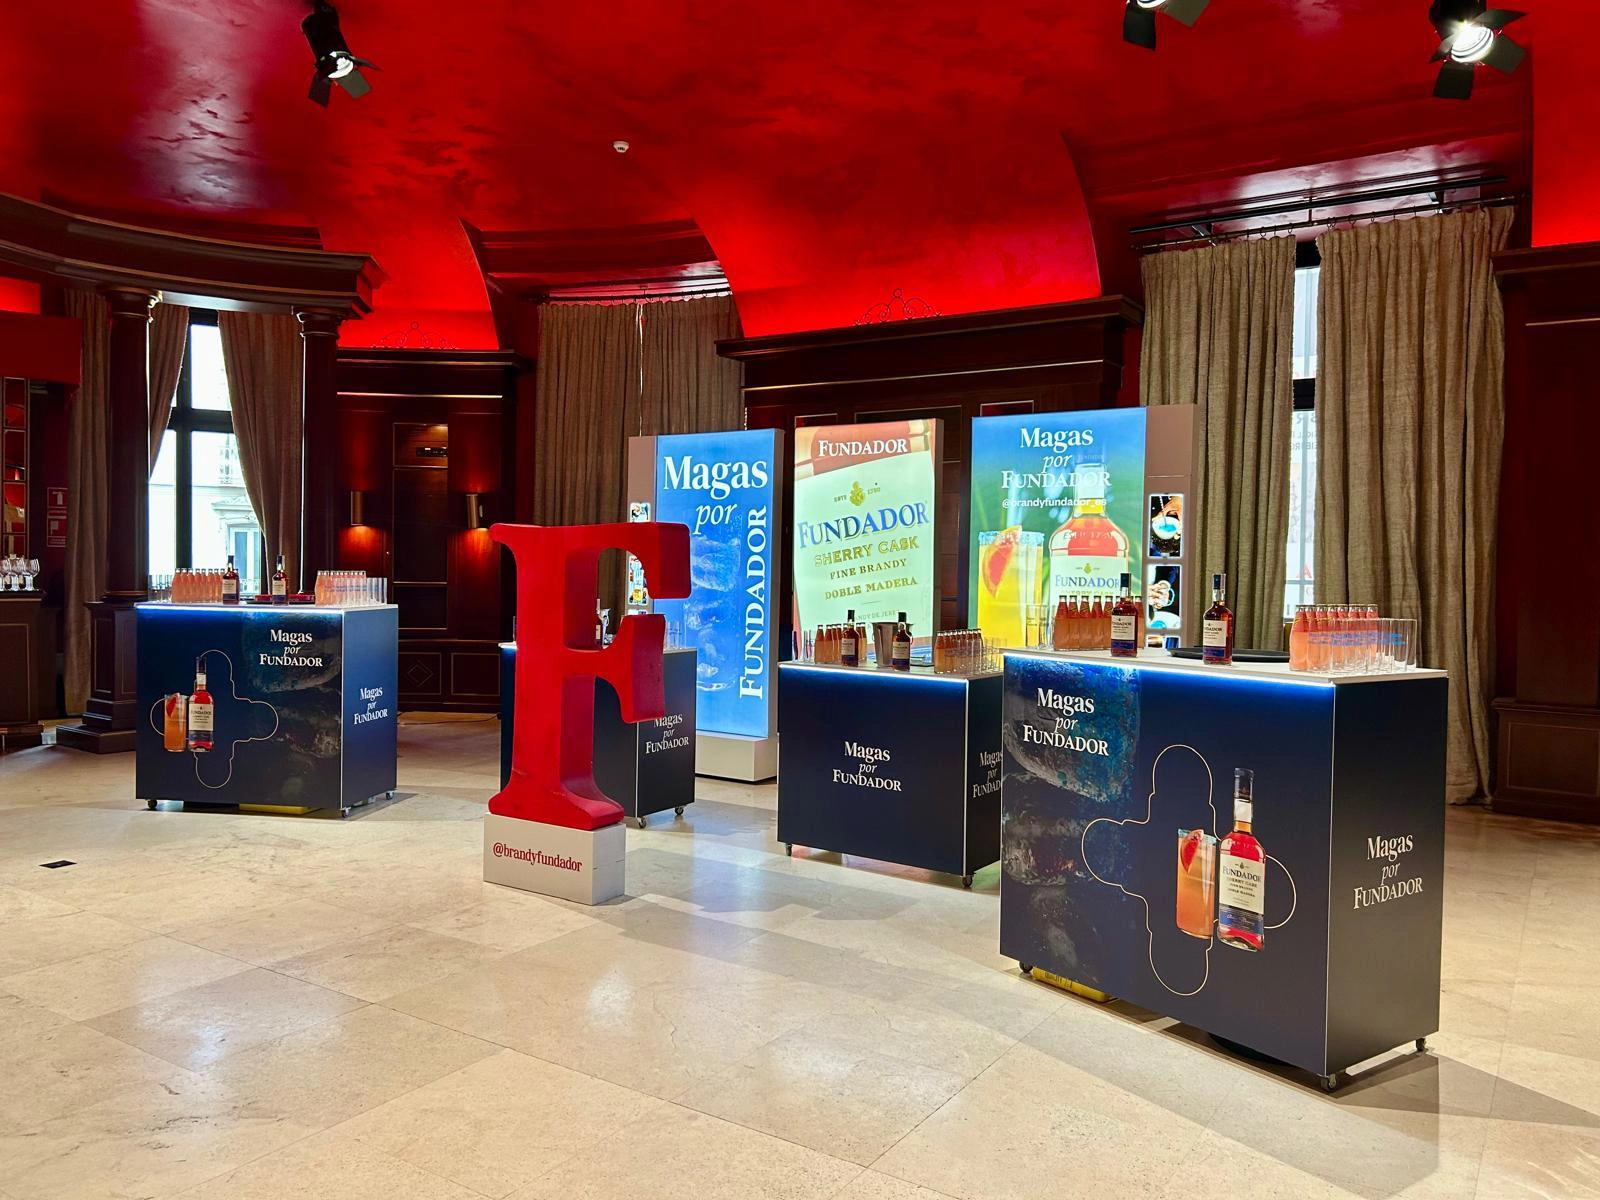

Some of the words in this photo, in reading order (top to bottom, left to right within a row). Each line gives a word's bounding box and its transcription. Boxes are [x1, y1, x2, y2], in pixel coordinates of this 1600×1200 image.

[818, 439, 908, 457] FUNDADOR
[1020, 427, 1094, 453] Magas
[1042, 454, 1072, 474] por
[664, 456, 768, 499] Magas
[1001, 470, 1112, 489] FUNDADOR
[692, 503, 737, 535] por
[798, 502, 929, 549] FUNDADOR
[815, 543, 873, 568] SHERRY
[878, 535, 920, 555] CASK
[829, 568, 857, 580] FINE
[860, 558, 907, 574] BRANDY
[825, 585, 862, 600] DOBLE
[866, 576, 918, 593] MADERA
[740, 505, 767, 699] FUNDADOR
[270, 629, 313, 646] Magas
[260, 653, 323, 667] FUNDADOR
[283, 645, 301, 657] por
[360, 686, 383, 701] Magas
[1037, 688, 1095, 716] Magas
[354, 708, 388, 725] FUNDADOR
[367, 701, 377, 713] por
[653, 713, 683, 728] Magas
[1054, 717, 1078, 733] por
[645, 736, 689, 754] FUNDADOR
[663, 728, 675, 742] por
[1023, 725, 1109, 756] FUNDADOR
[844, 741, 890, 762] Magas
[859, 763, 877, 775] por
[987, 768, 997, 784] por
[832, 769, 902, 792] FUNDADOR
[973, 780, 1001, 798] FUNDAD
[493, 842, 583, 872] @brandyfundador
[1367, 835, 1413, 861] Magas
[1381, 863, 1401, 886] por
[1353, 877, 1423, 909] FUNDADOR
